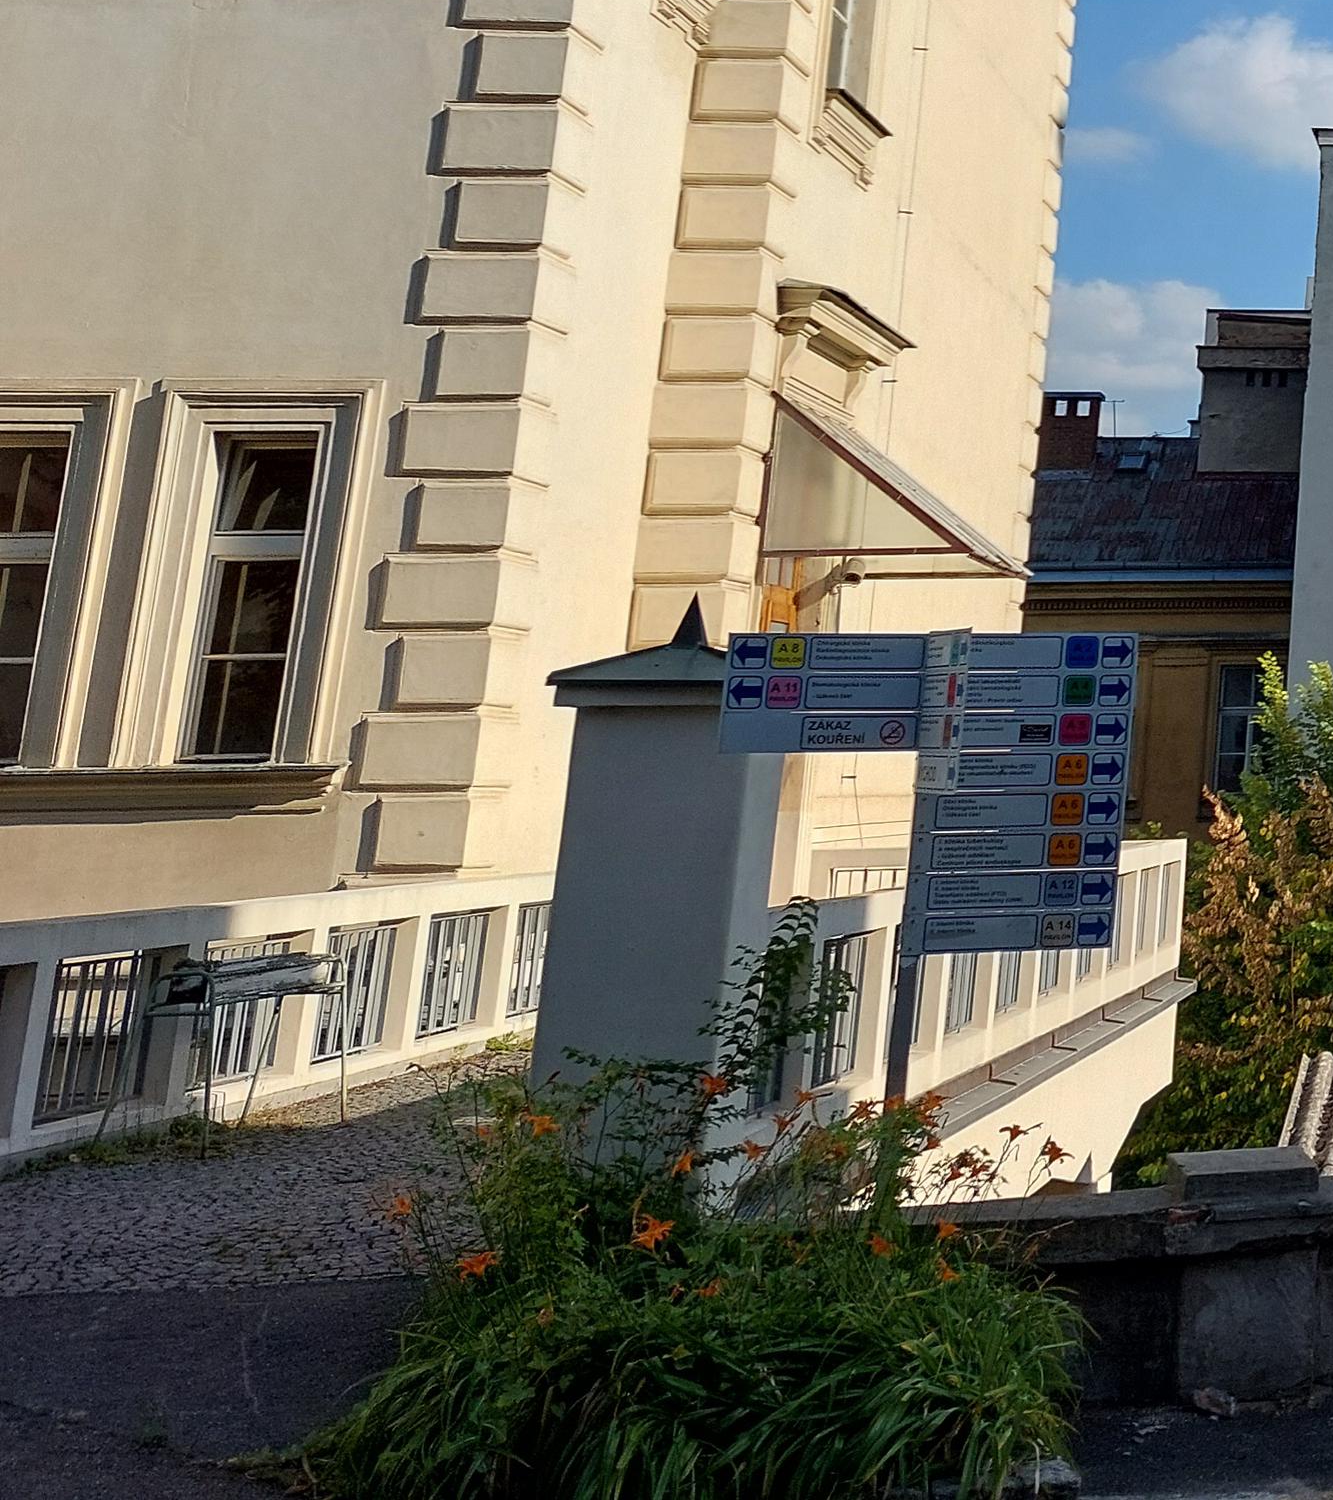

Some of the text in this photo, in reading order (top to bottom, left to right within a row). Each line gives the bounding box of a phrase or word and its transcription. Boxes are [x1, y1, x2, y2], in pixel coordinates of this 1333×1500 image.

[778, 643, 800, 653] A 8
[771, 683, 798, 693] A 11
[808, 719, 852, 731] ZÁKAZ
[807, 732, 866, 745] KOUŘENÍ
[1064, 759, 1082, 769] A 6
[1058, 799, 1078, 810] A 6
[1055, 839, 1076, 850] A 6
[1048, 879, 1075, 890] A 12
[1045, 921, 1072, 932] A 14
